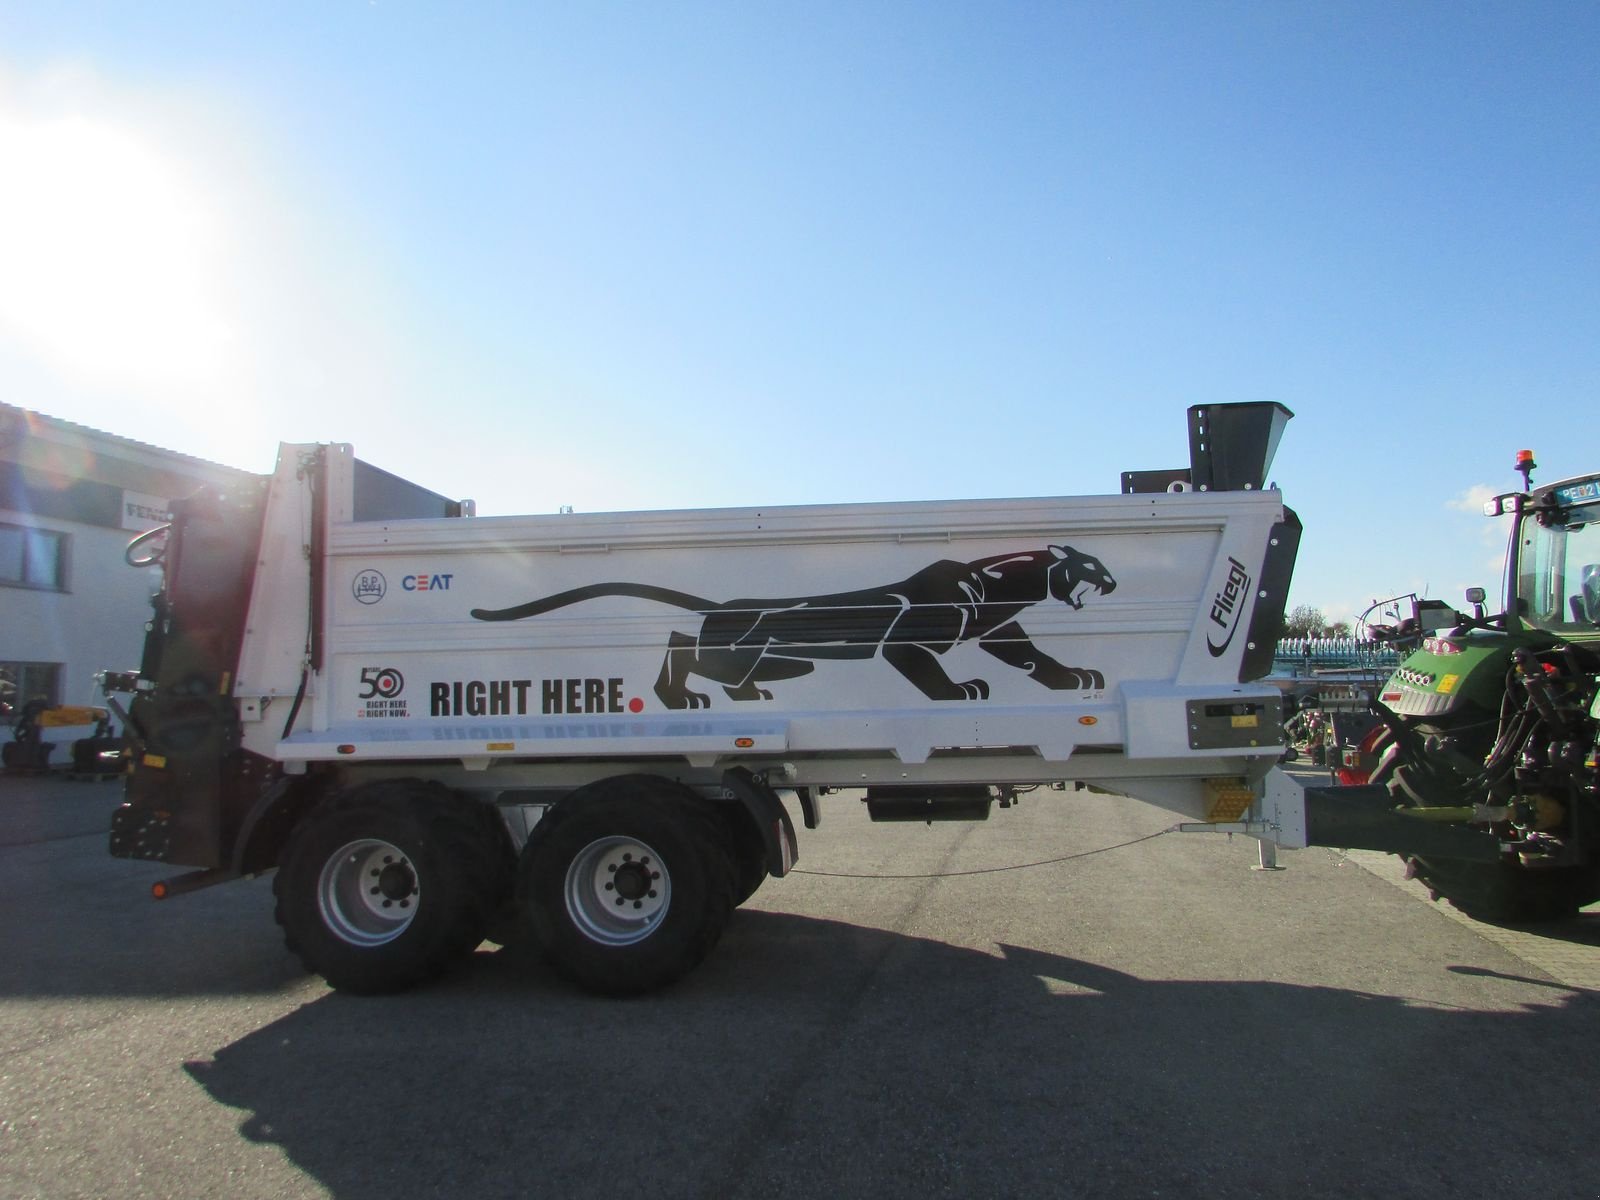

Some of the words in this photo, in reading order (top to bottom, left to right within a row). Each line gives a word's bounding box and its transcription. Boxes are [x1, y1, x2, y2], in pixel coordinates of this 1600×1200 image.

[402, 574, 454, 591] CEAT
[1210, 556, 1248, 629] Fliegl
[358, 667, 405, 699] 50
[366, 701, 388, 709] RIGHT
[389, 700, 407, 709] HERE
[431, 680, 532, 717] RIGHT
[366, 709, 388, 718] RIGHT
